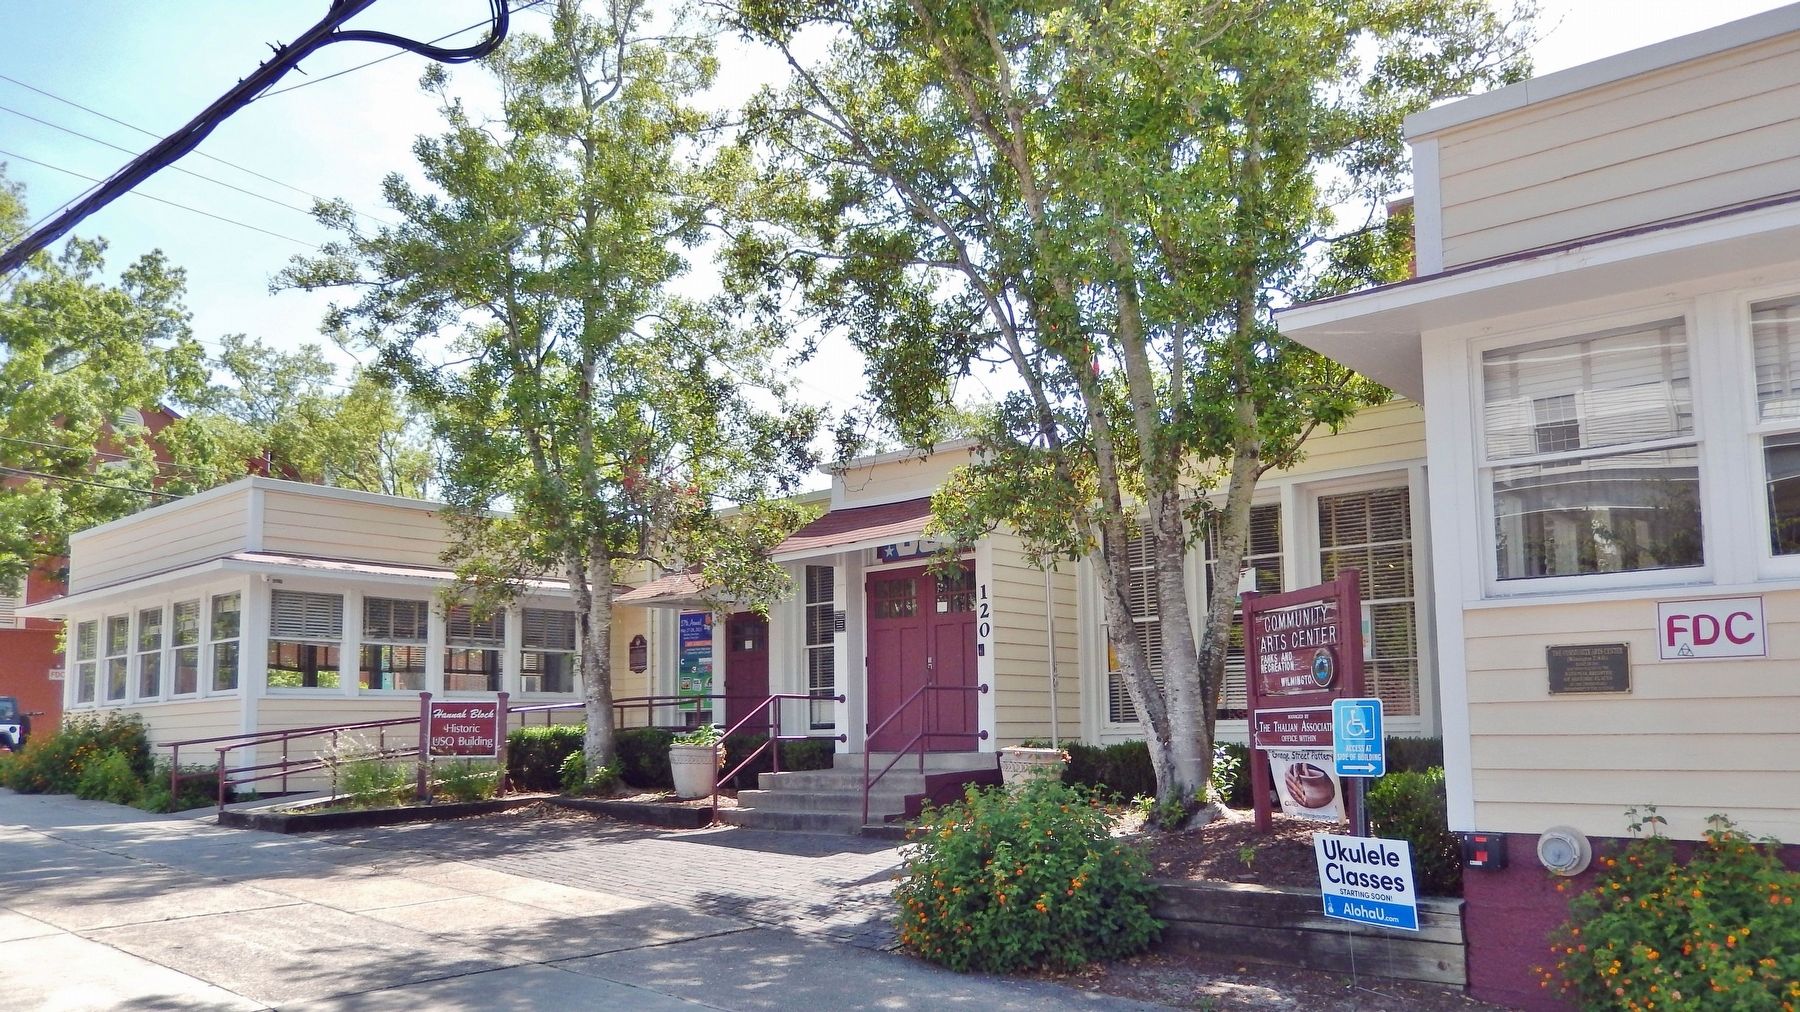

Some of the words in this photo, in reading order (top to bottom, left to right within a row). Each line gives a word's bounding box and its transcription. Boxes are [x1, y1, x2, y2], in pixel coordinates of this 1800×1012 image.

[979, 584, 991, 638] 120
[1264, 605, 1328, 633] COMMUNITY
[1666, 611, 1755, 647] FDC
[1260, 633, 1287, 653] ARTS
[1291, 626, 1336, 648] CENTER
[1260, 653, 1278, 665] PARKS
[1281, 651, 1293, 662] AND
[1260, 660, 1295, 674] RECREATION
[1280, 675, 1314, 687] WILMINGTO
[433, 709, 467, 719] Hannah
[470, 709, 494, 719] Block
[446, 723, 481, 733] Historic
[1259, 721, 1271, 733] THE
[1273, 721, 1298, 732] THALIAN
[1301, 720, 1333, 732] ASSOCIATI
[458, 735, 493, 748] Building
[1299, 734, 1317, 742] WITHIN
[1345, 744, 1365, 752] ACCESS
[1365, 744, 1372, 752] AT
[1291, 751, 1310, 760] Street
[1349, 753, 1357, 761] OF
[1357, 753, 1382, 761] BUILDING
[1322, 839, 1400, 867] Ukulele
[1325, 862, 1405, 892] Classes
[1340, 888, 1370, 899] STARTING
[1370, 893, 1393, 902] SOON!
[1343, 902, 1400, 923] AlohaU.com
